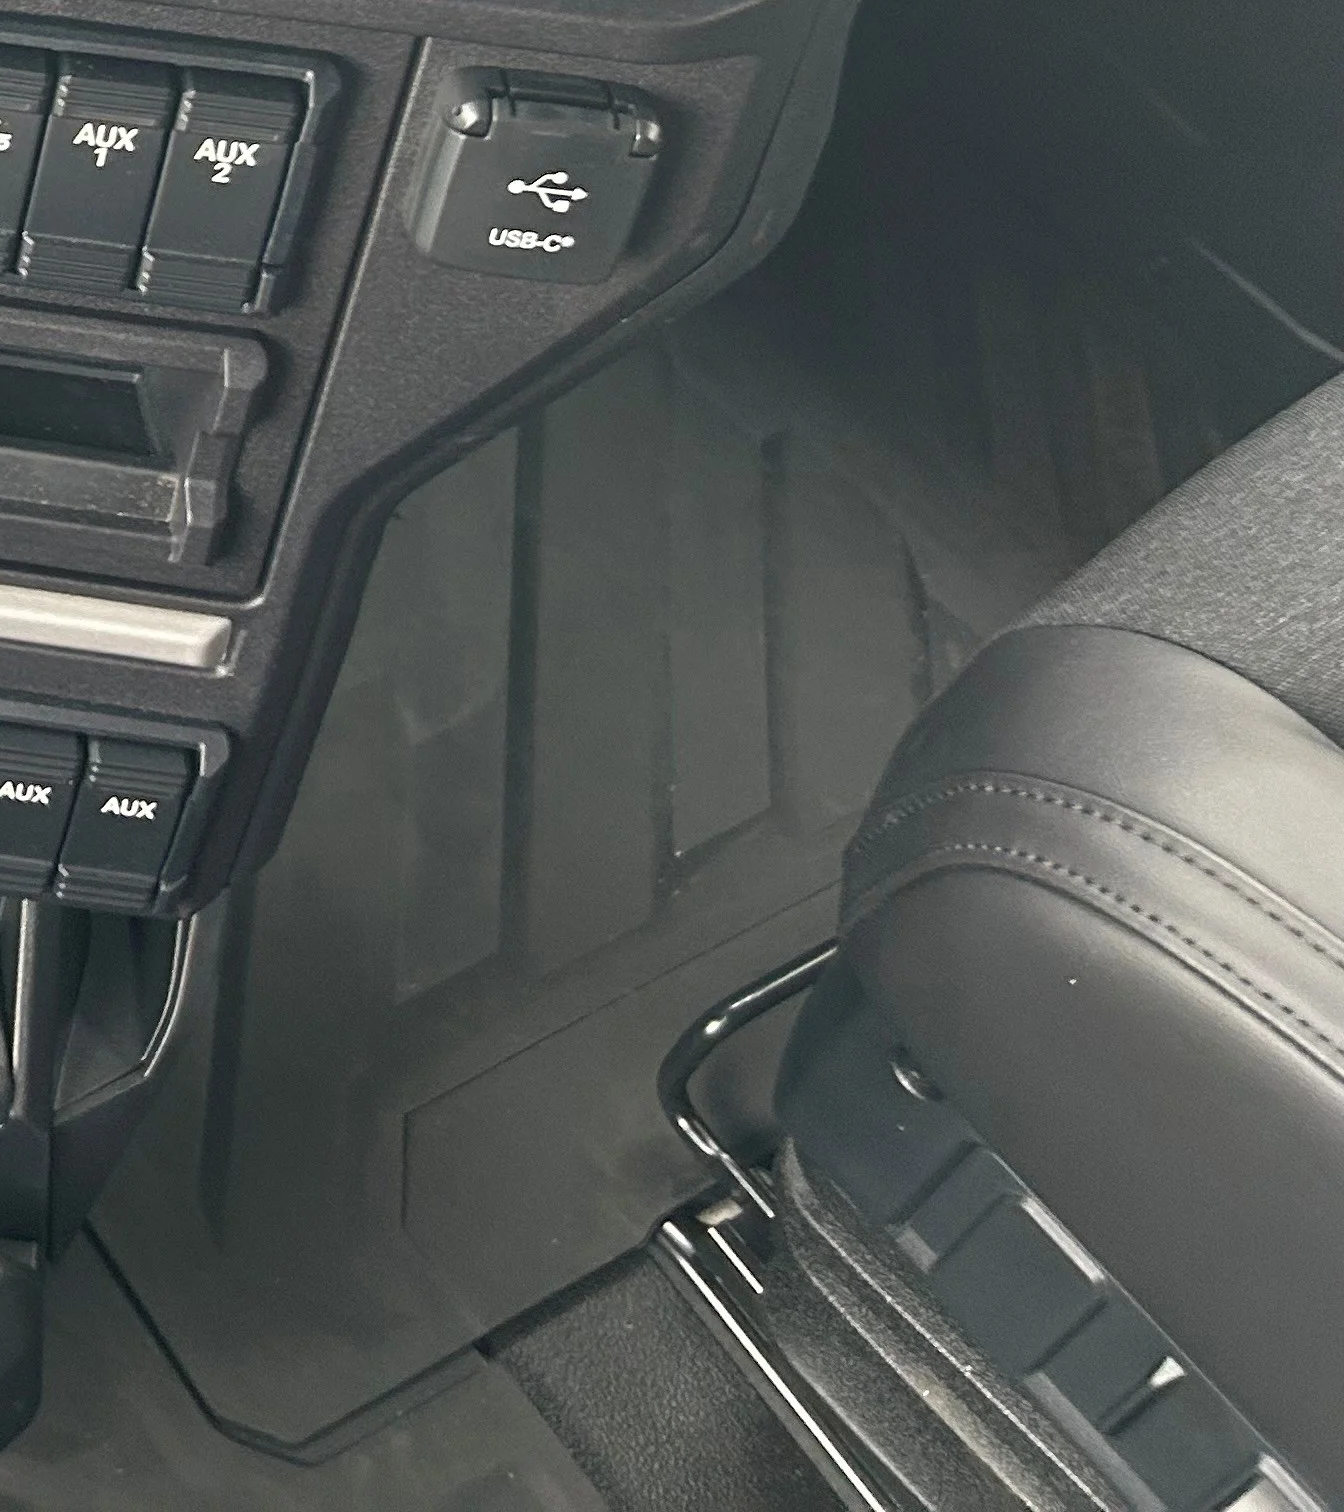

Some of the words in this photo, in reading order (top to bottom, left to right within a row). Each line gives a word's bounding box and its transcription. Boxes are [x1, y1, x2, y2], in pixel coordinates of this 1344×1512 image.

[73, 122, 137, 152] AUX
[94, 146, 108, 168] 1
[193, 137, 260, 167] AUX
[212, 162, 232, 185] 2
[101, 797, 157, 819] AUX
